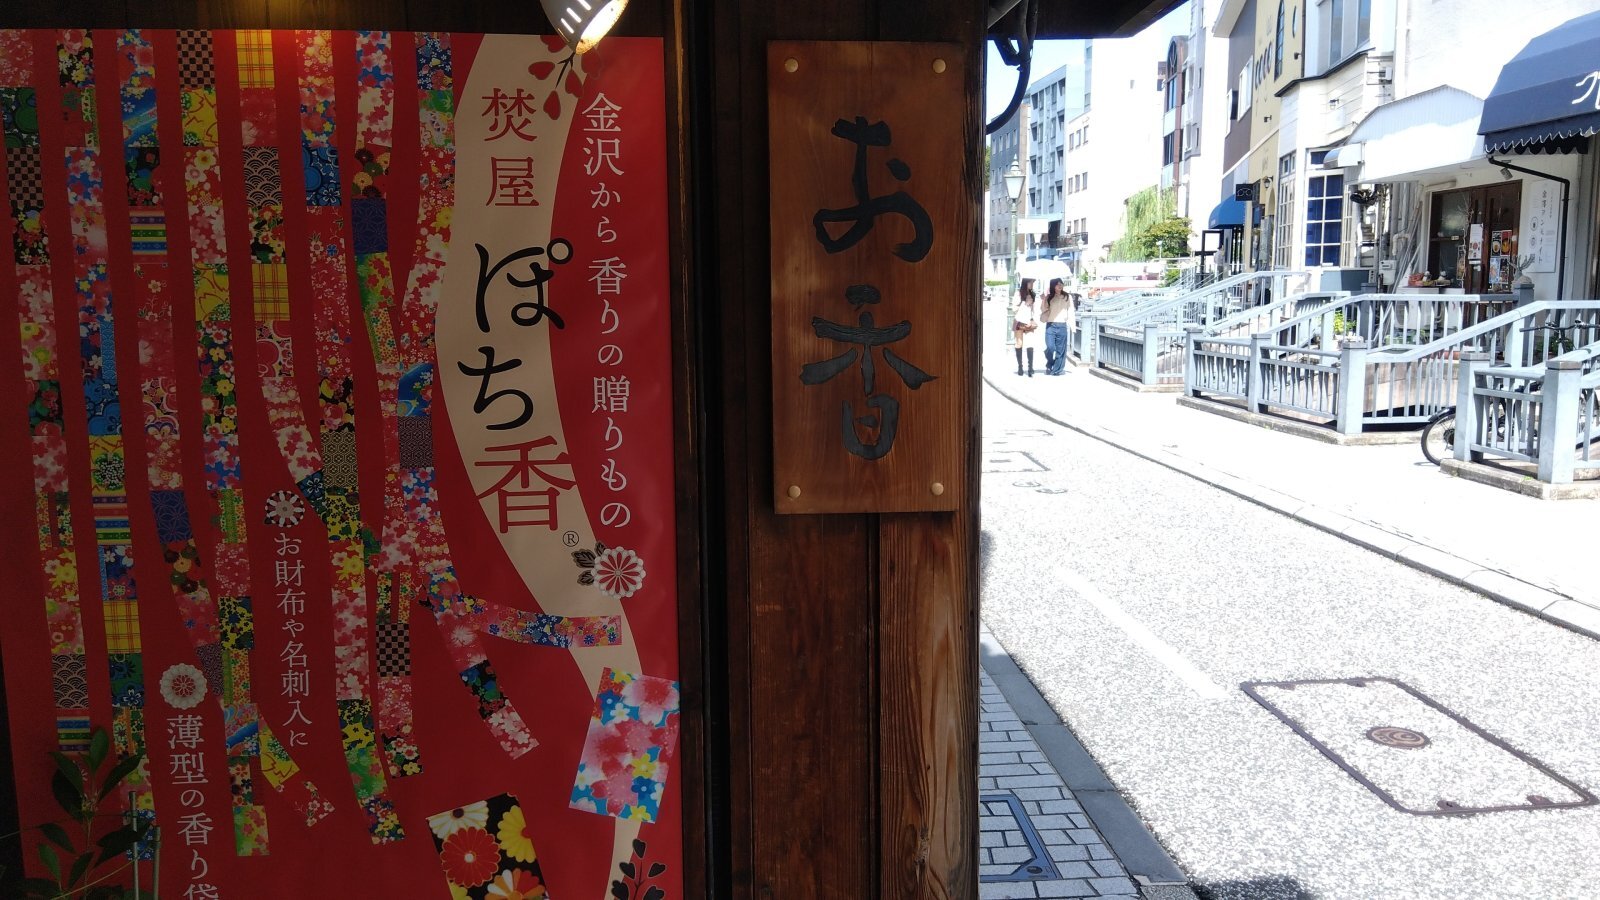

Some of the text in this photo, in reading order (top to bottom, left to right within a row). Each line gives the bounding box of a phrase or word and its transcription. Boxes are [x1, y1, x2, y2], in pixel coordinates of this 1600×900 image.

[481, 88, 539, 207] 焚屋
[798, 115, 938, 461] お香
[457, 237, 577, 534] ぽち香
[581, 92, 631, 529] 金沢から香りの贈りもの
[272, 532, 313, 748] お財布や名刺入に
